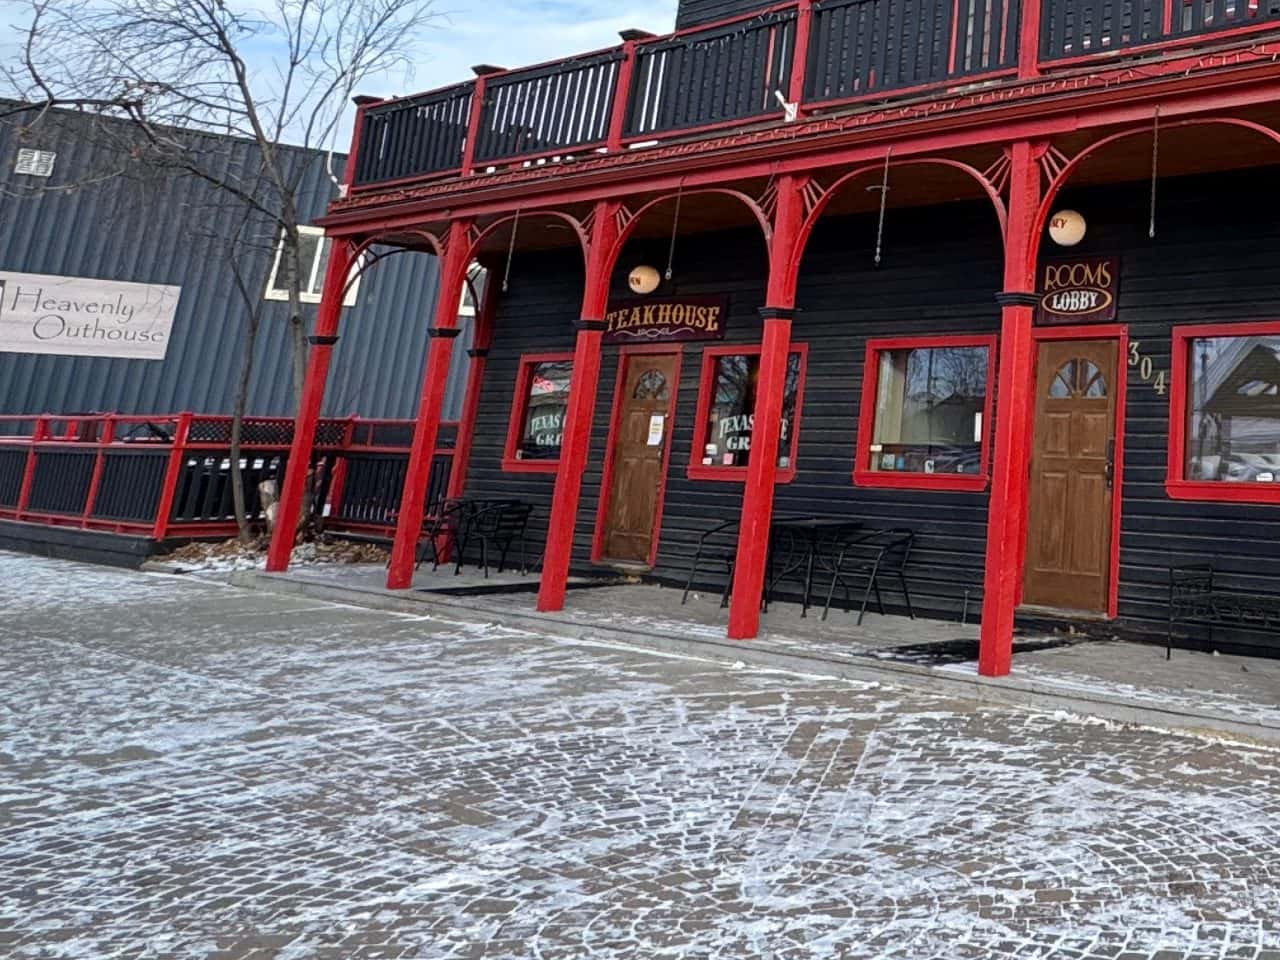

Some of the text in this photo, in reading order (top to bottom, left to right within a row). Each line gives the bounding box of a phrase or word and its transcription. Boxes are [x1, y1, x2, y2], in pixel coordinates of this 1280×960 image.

[1045, 261, 1112, 290] ROOMS
[11, 286, 135, 324] Heavenly
[1052, 290, 1099, 311] LOBBY
[33, 314, 165, 343] Outhouse
[606, 303, 720, 332] TEAKHOUSE
[1128, 341, 1167, 395] 304
[530, 414, 561, 436] TEXAS
[720, 414, 755, 439] TEXAS
